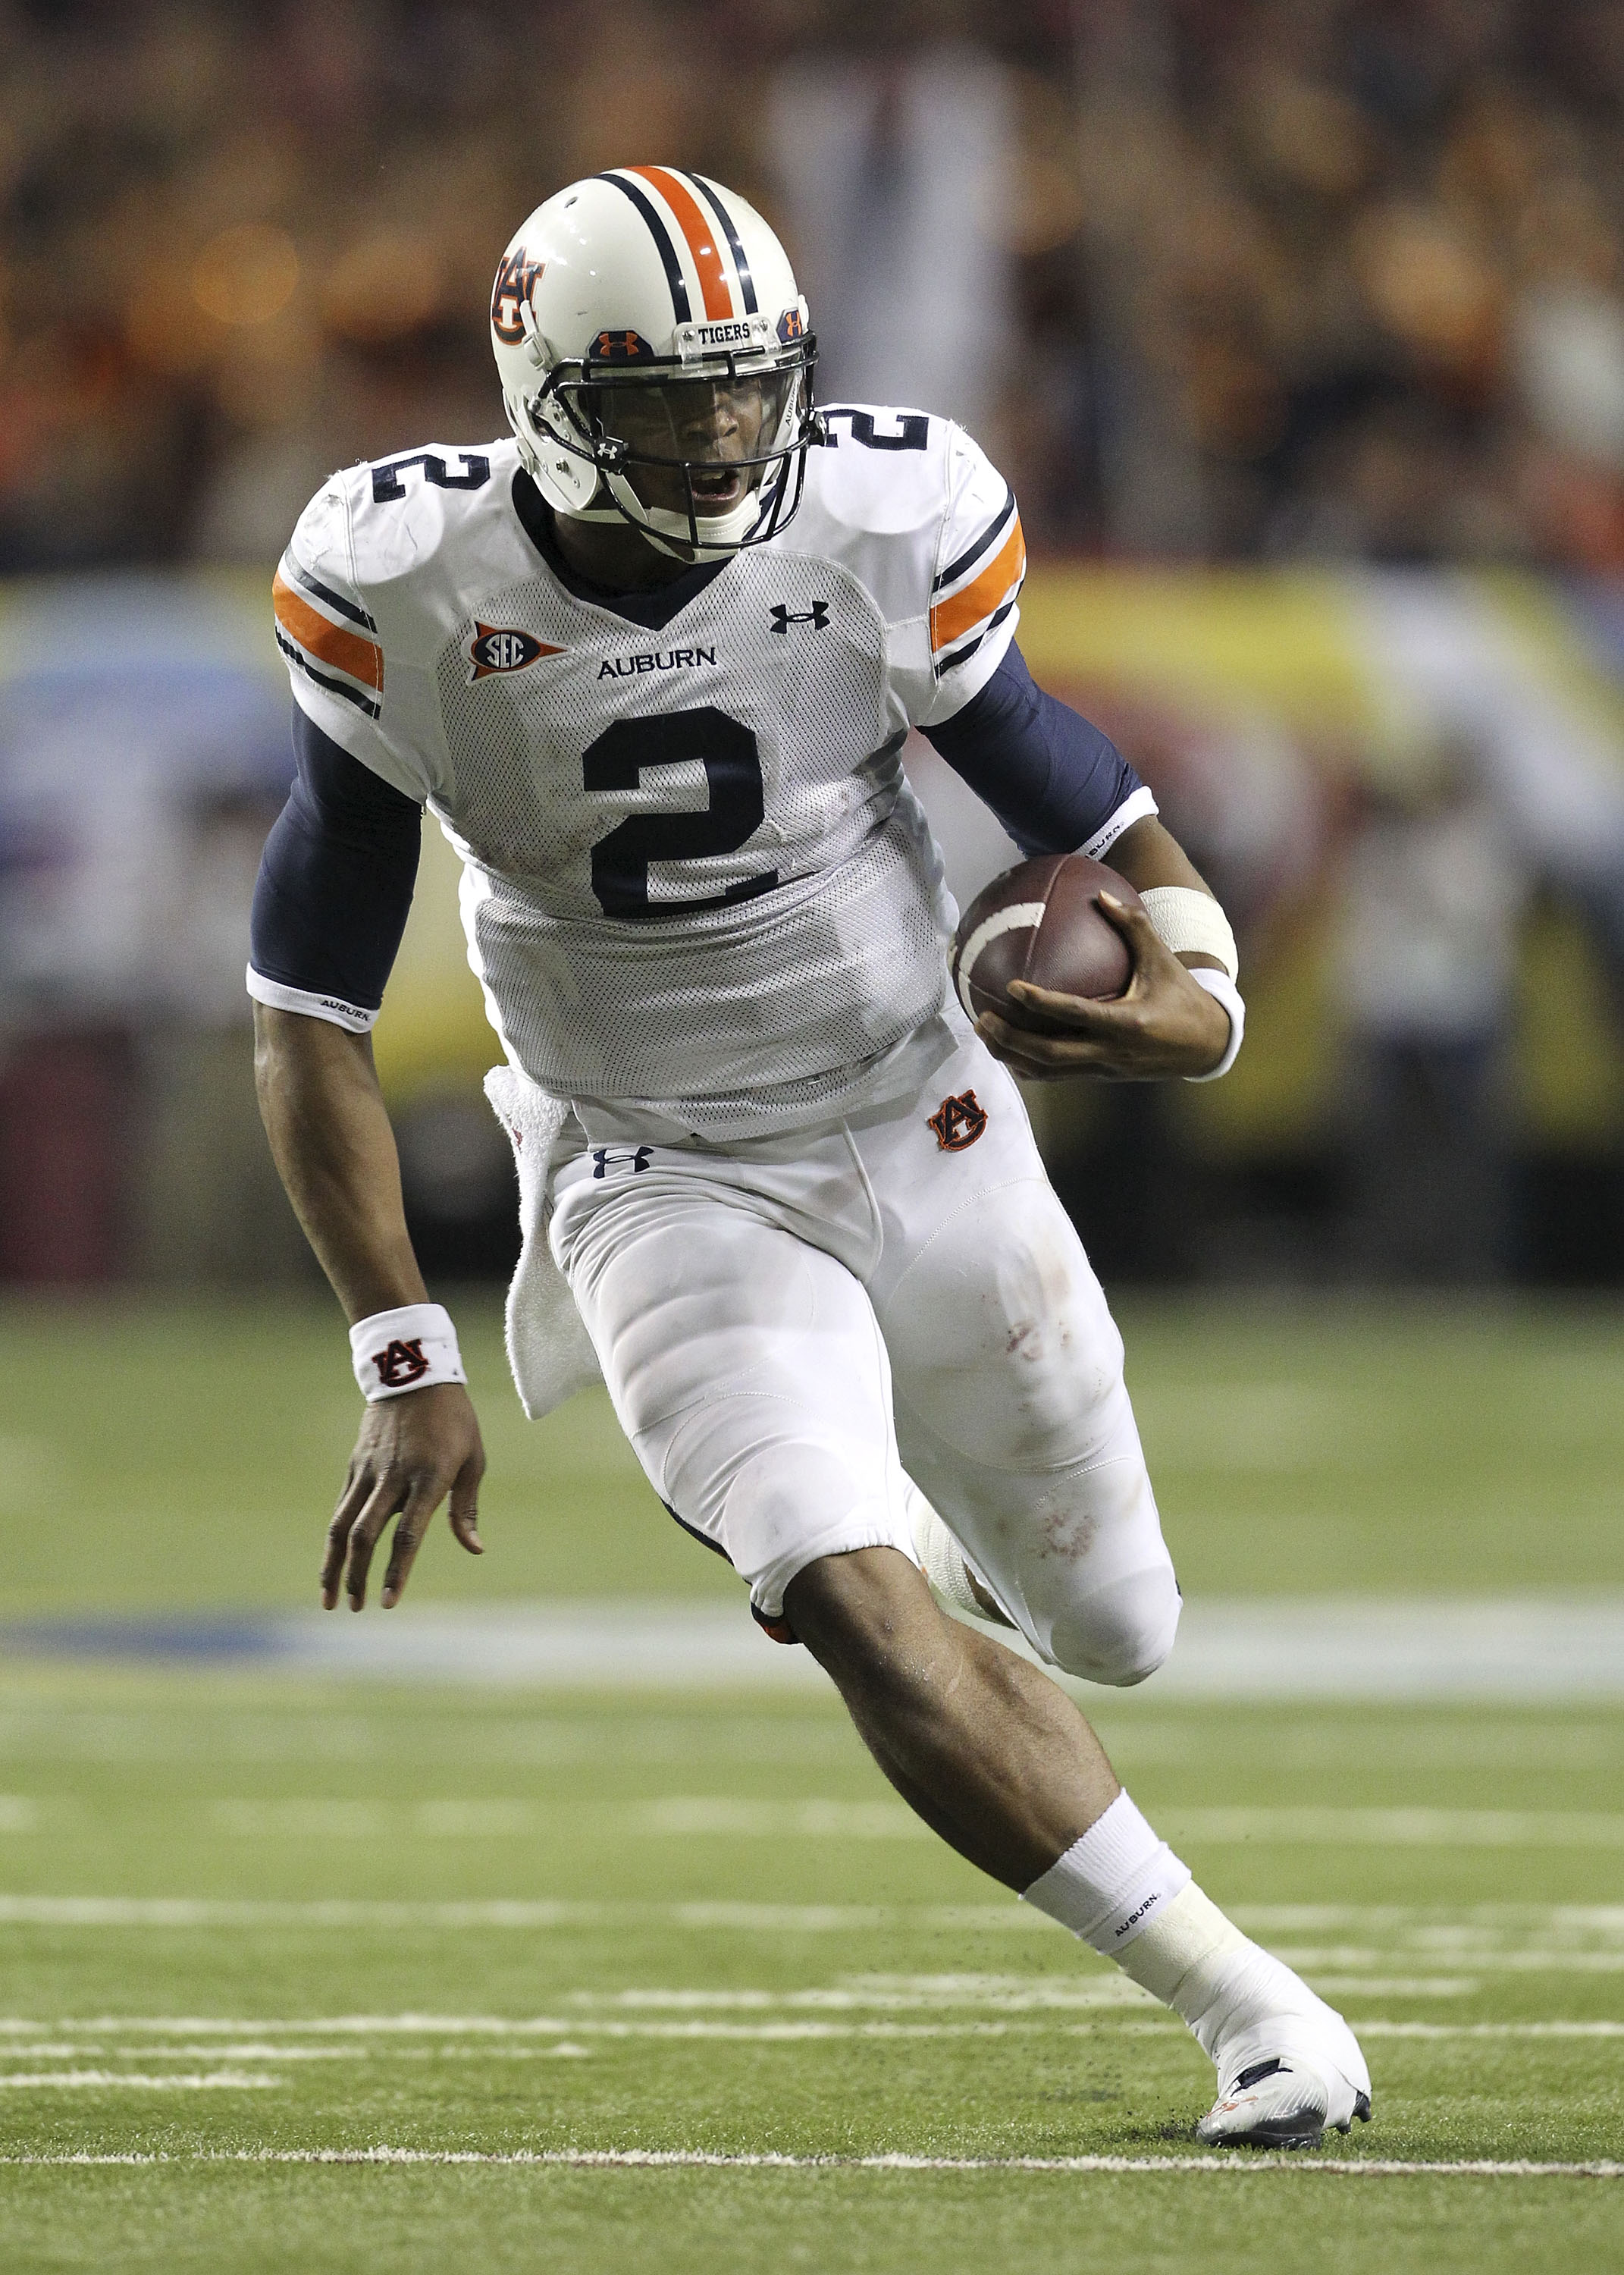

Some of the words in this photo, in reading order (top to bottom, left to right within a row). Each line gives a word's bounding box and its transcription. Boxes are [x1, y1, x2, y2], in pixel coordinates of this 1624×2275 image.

[698, 322, 750, 344] TIGERS
[823, 409, 930, 450] 2
[372, 453, 491, 504] 2
[485, 634, 524, 668] SEC
[597, 647, 716, 680] AUBURN
[582, 705, 779, 918] 2
[1085, 824, 1121, 858] BURN
[321, 999, 369, 1022] AUBURN
[1115, 1893, 1158, 1937] AUBURN
